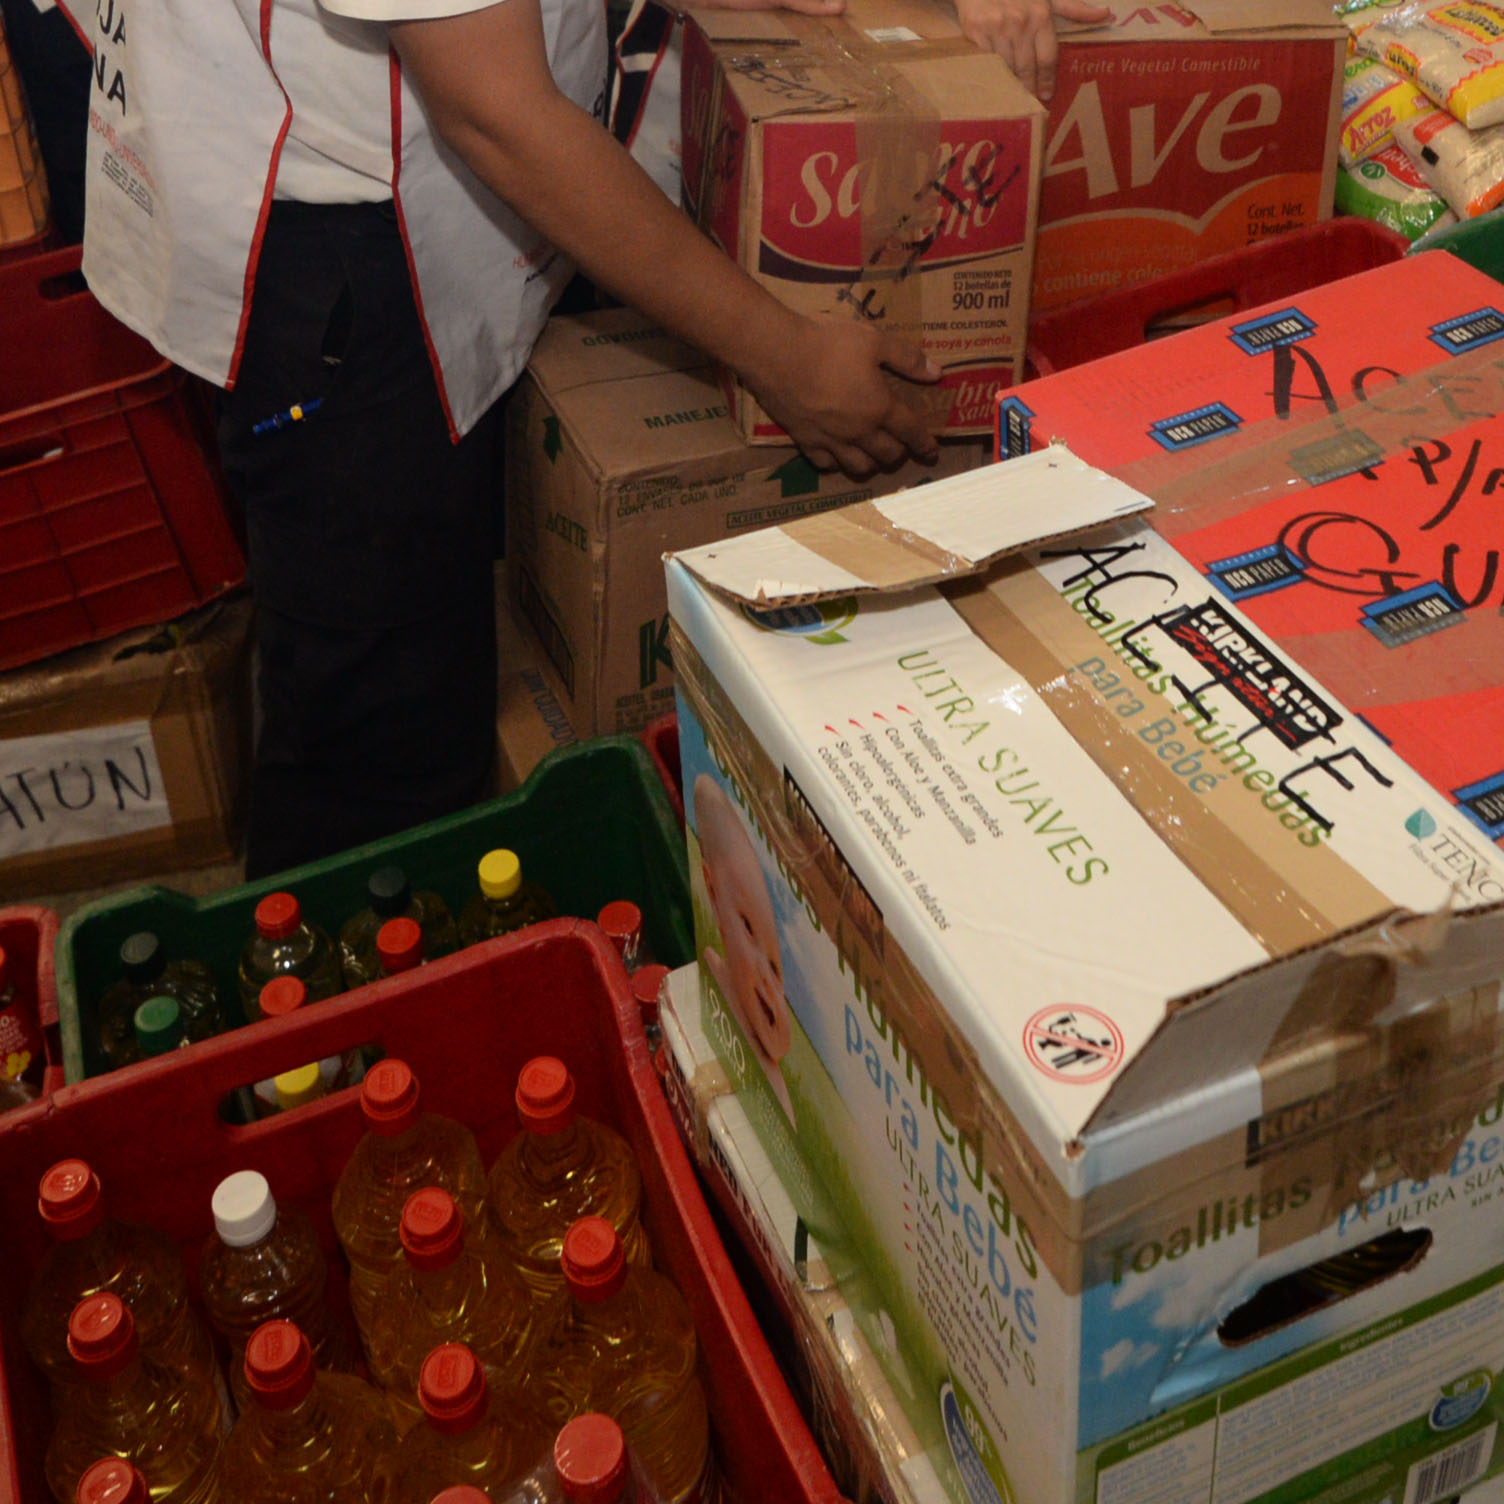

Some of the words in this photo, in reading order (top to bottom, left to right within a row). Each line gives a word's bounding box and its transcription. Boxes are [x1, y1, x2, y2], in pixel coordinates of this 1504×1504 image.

[1069, 57, 1115, 74] Aceite
[1119, 56, 1177, 76] Vegetal
[1180, 55, 1262, 74] Comestible
[1041, 78, 1284, 200] Ave
[1348, 105, 1397, 152] Arroz
[952, 292, 986, 311] 900
[989, 290, 1011, 309] ml
[965, 279, 999, 291] botellas
[1000, 278, 1013, 289] de
[1043, 271, 1124, 294] contiene
[950, 317, 1008, 331] COLESTEROL
[974, 333, 1013, 348] canola
[644, 405, 729, 430] MANEJE
[1167, 422, 1193, 443] NCR
[1192, 412, 1230, 435] PAPER
[1223, 566, 1253, 590] NCR
[1252, 556, 1290, 584] PAPER
[1190, 608, 1330, 736] KIRKLAND
[1059, 574, 1175, 697] Toallitas
[1171, 691, 1335, 849] Húmedas
[1066, 654, 1147, 721] para
[1137, 715, 1230, 795] Bebé
[884, 725, 906, 750] Con
[897, 650, 991, 746] ULTRA
[977, 747, 1110, 887] SUAVES
[960, 792, 1004, 840] grandes
[843, 1002, 920, 1152] para
[935, 1138, 1039, 1345] Bebé
[1385, 1182, 1457, 1230] ULTRA
[885, 1114, 947, 1239] ULTRA
[950, 1228, 1037, 1389] SUAVES
[1108, 1173, 1314, 1287] Toallitas
